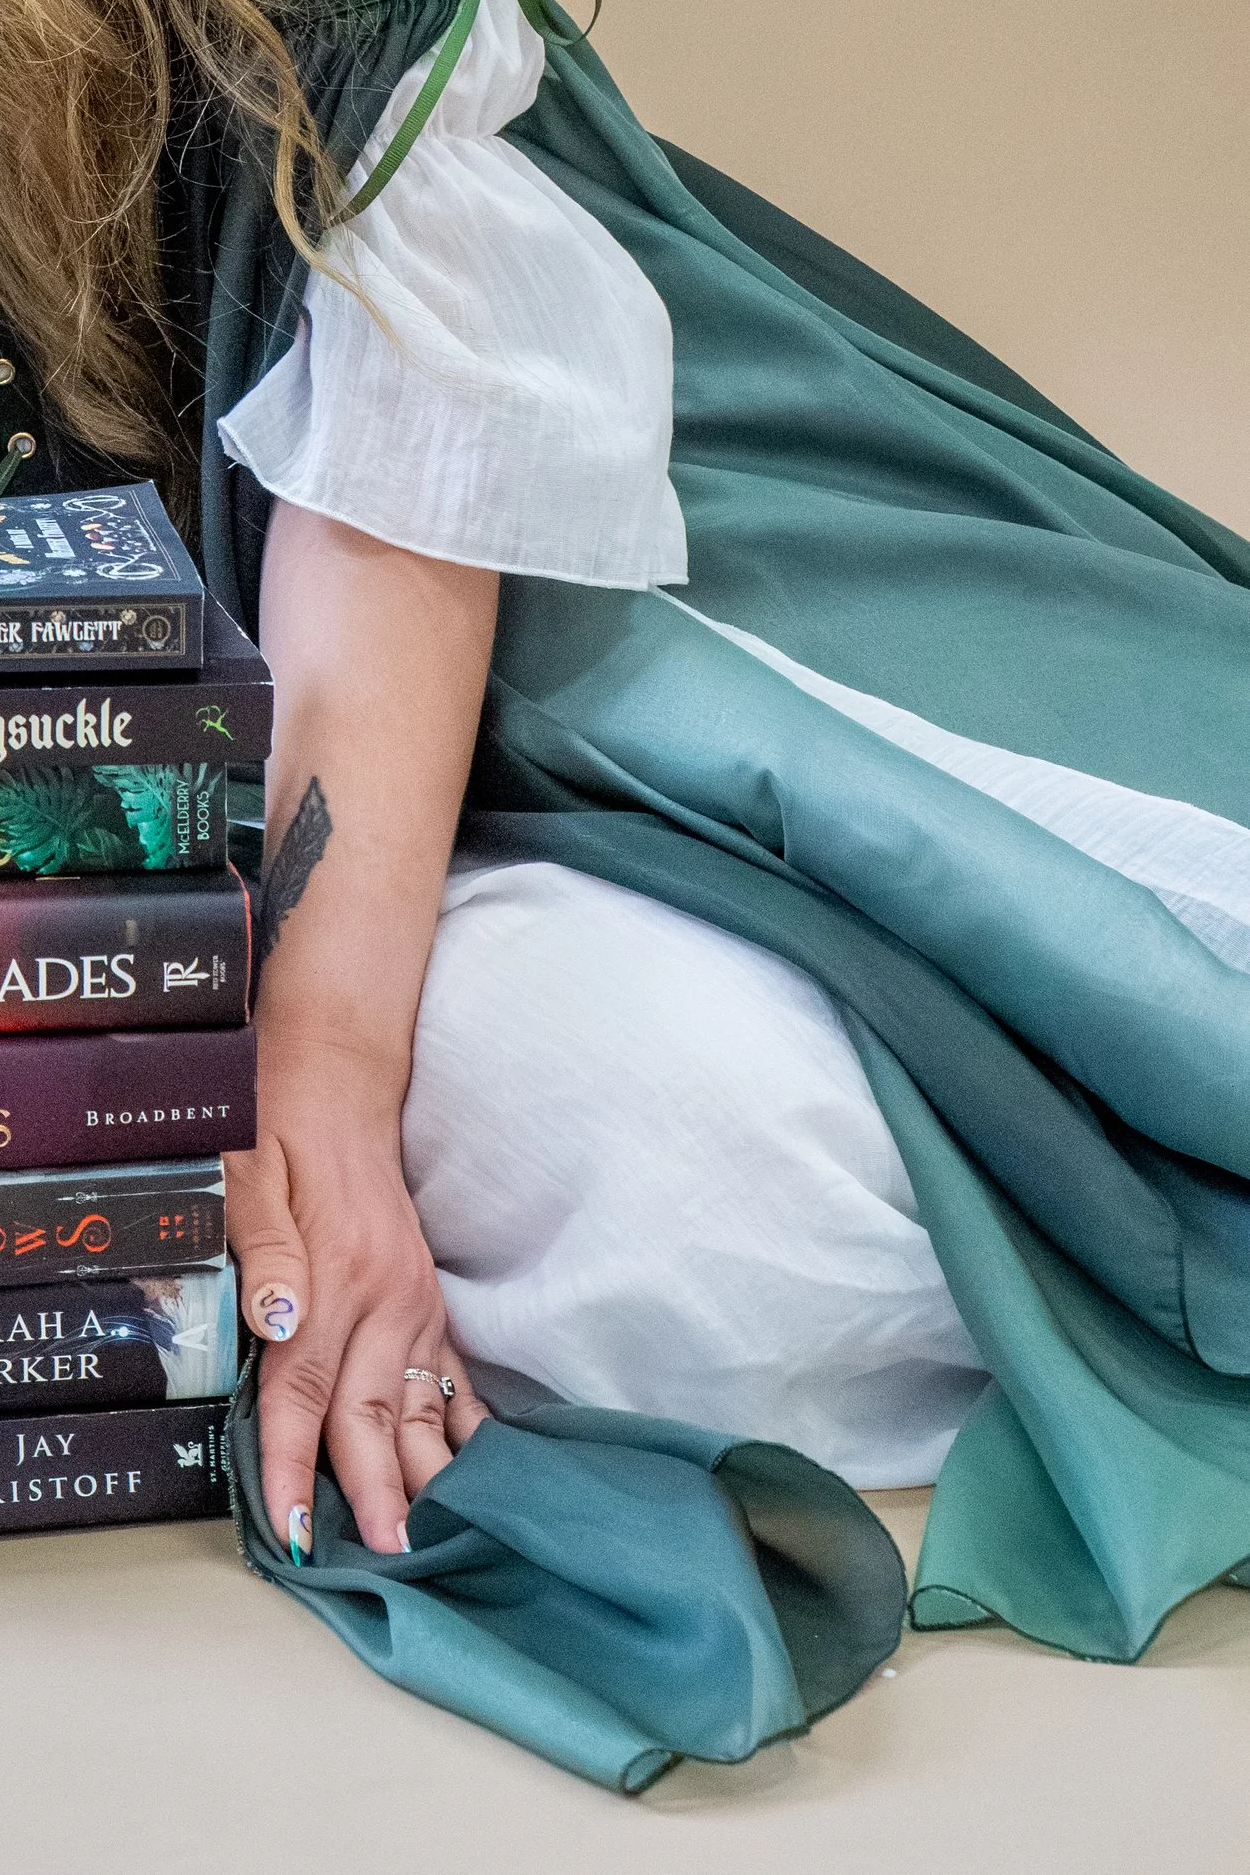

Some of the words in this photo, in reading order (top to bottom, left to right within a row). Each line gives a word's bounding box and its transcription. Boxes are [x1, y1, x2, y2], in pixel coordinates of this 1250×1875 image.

[31, 619, 123, 644] FAWCETT
[196, 791, 210, 840] BOOKS
[86, 1105, 230, 1126] BROADBENT
[16, 1433, 76, 1466] JAY
[208, 1425, 216, 1467] MARTIN'S
